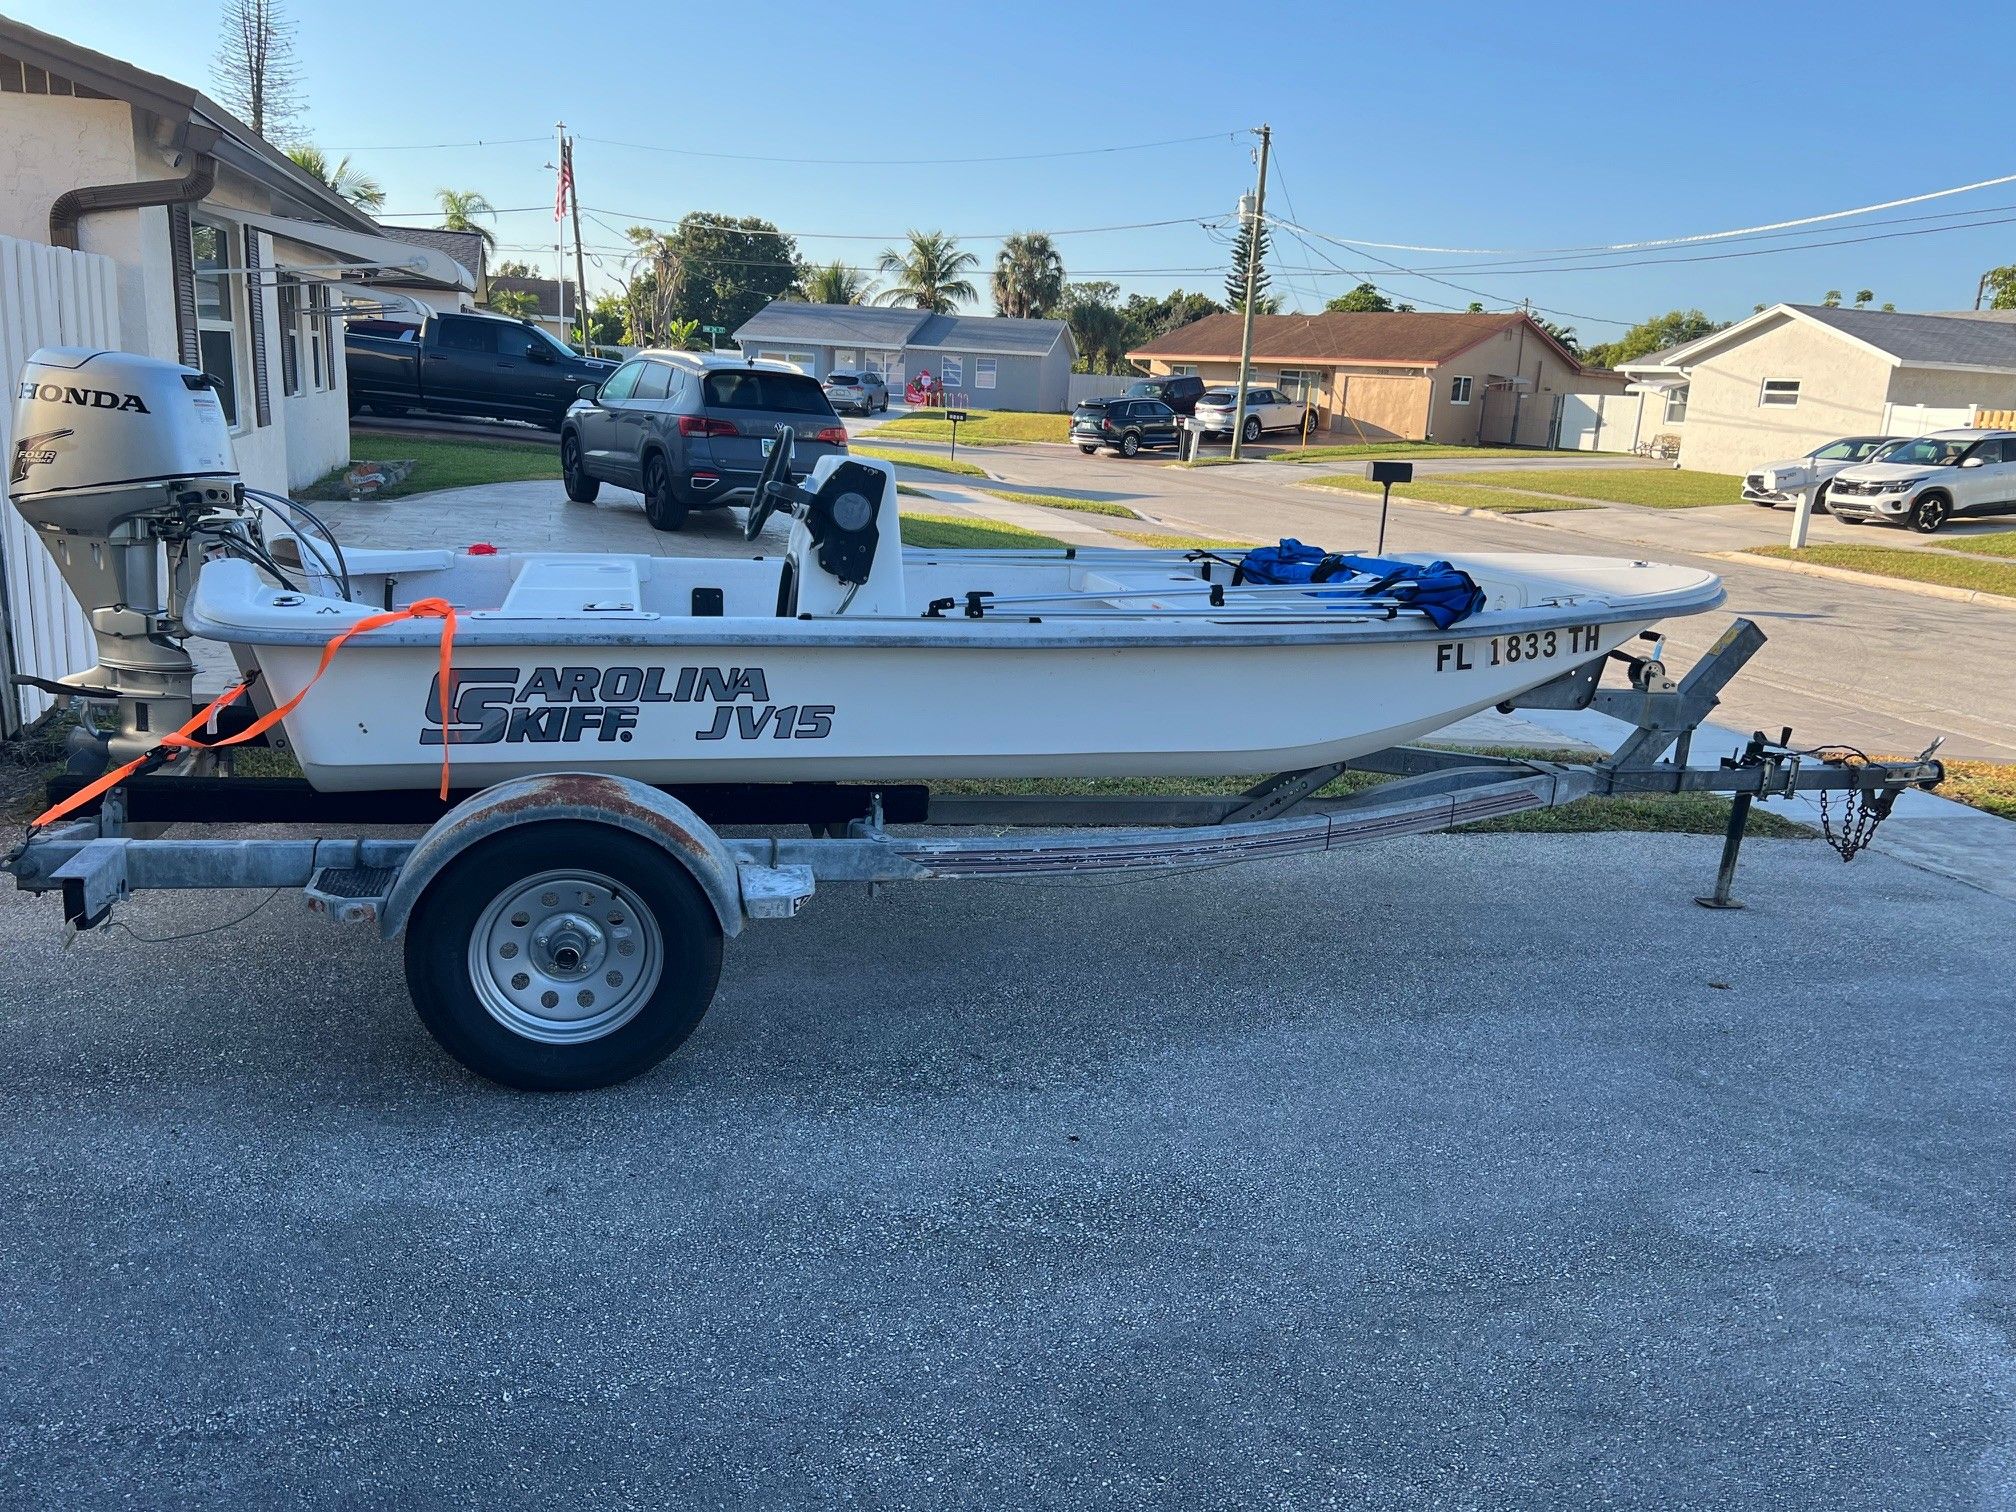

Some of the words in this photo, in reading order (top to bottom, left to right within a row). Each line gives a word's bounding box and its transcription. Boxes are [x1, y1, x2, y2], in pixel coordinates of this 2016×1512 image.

[18, 382, 152, 415] HONDA
[18, 450, 57, 459] FOUR
[1436, 643, 1473, 672] FL
[1490, 630, 1557, 666] 1833
[1568, 624, 1600, 654] TH
[425, 667, 770, 725] CAROLINA
[695, 705, 836, 740] JV15
